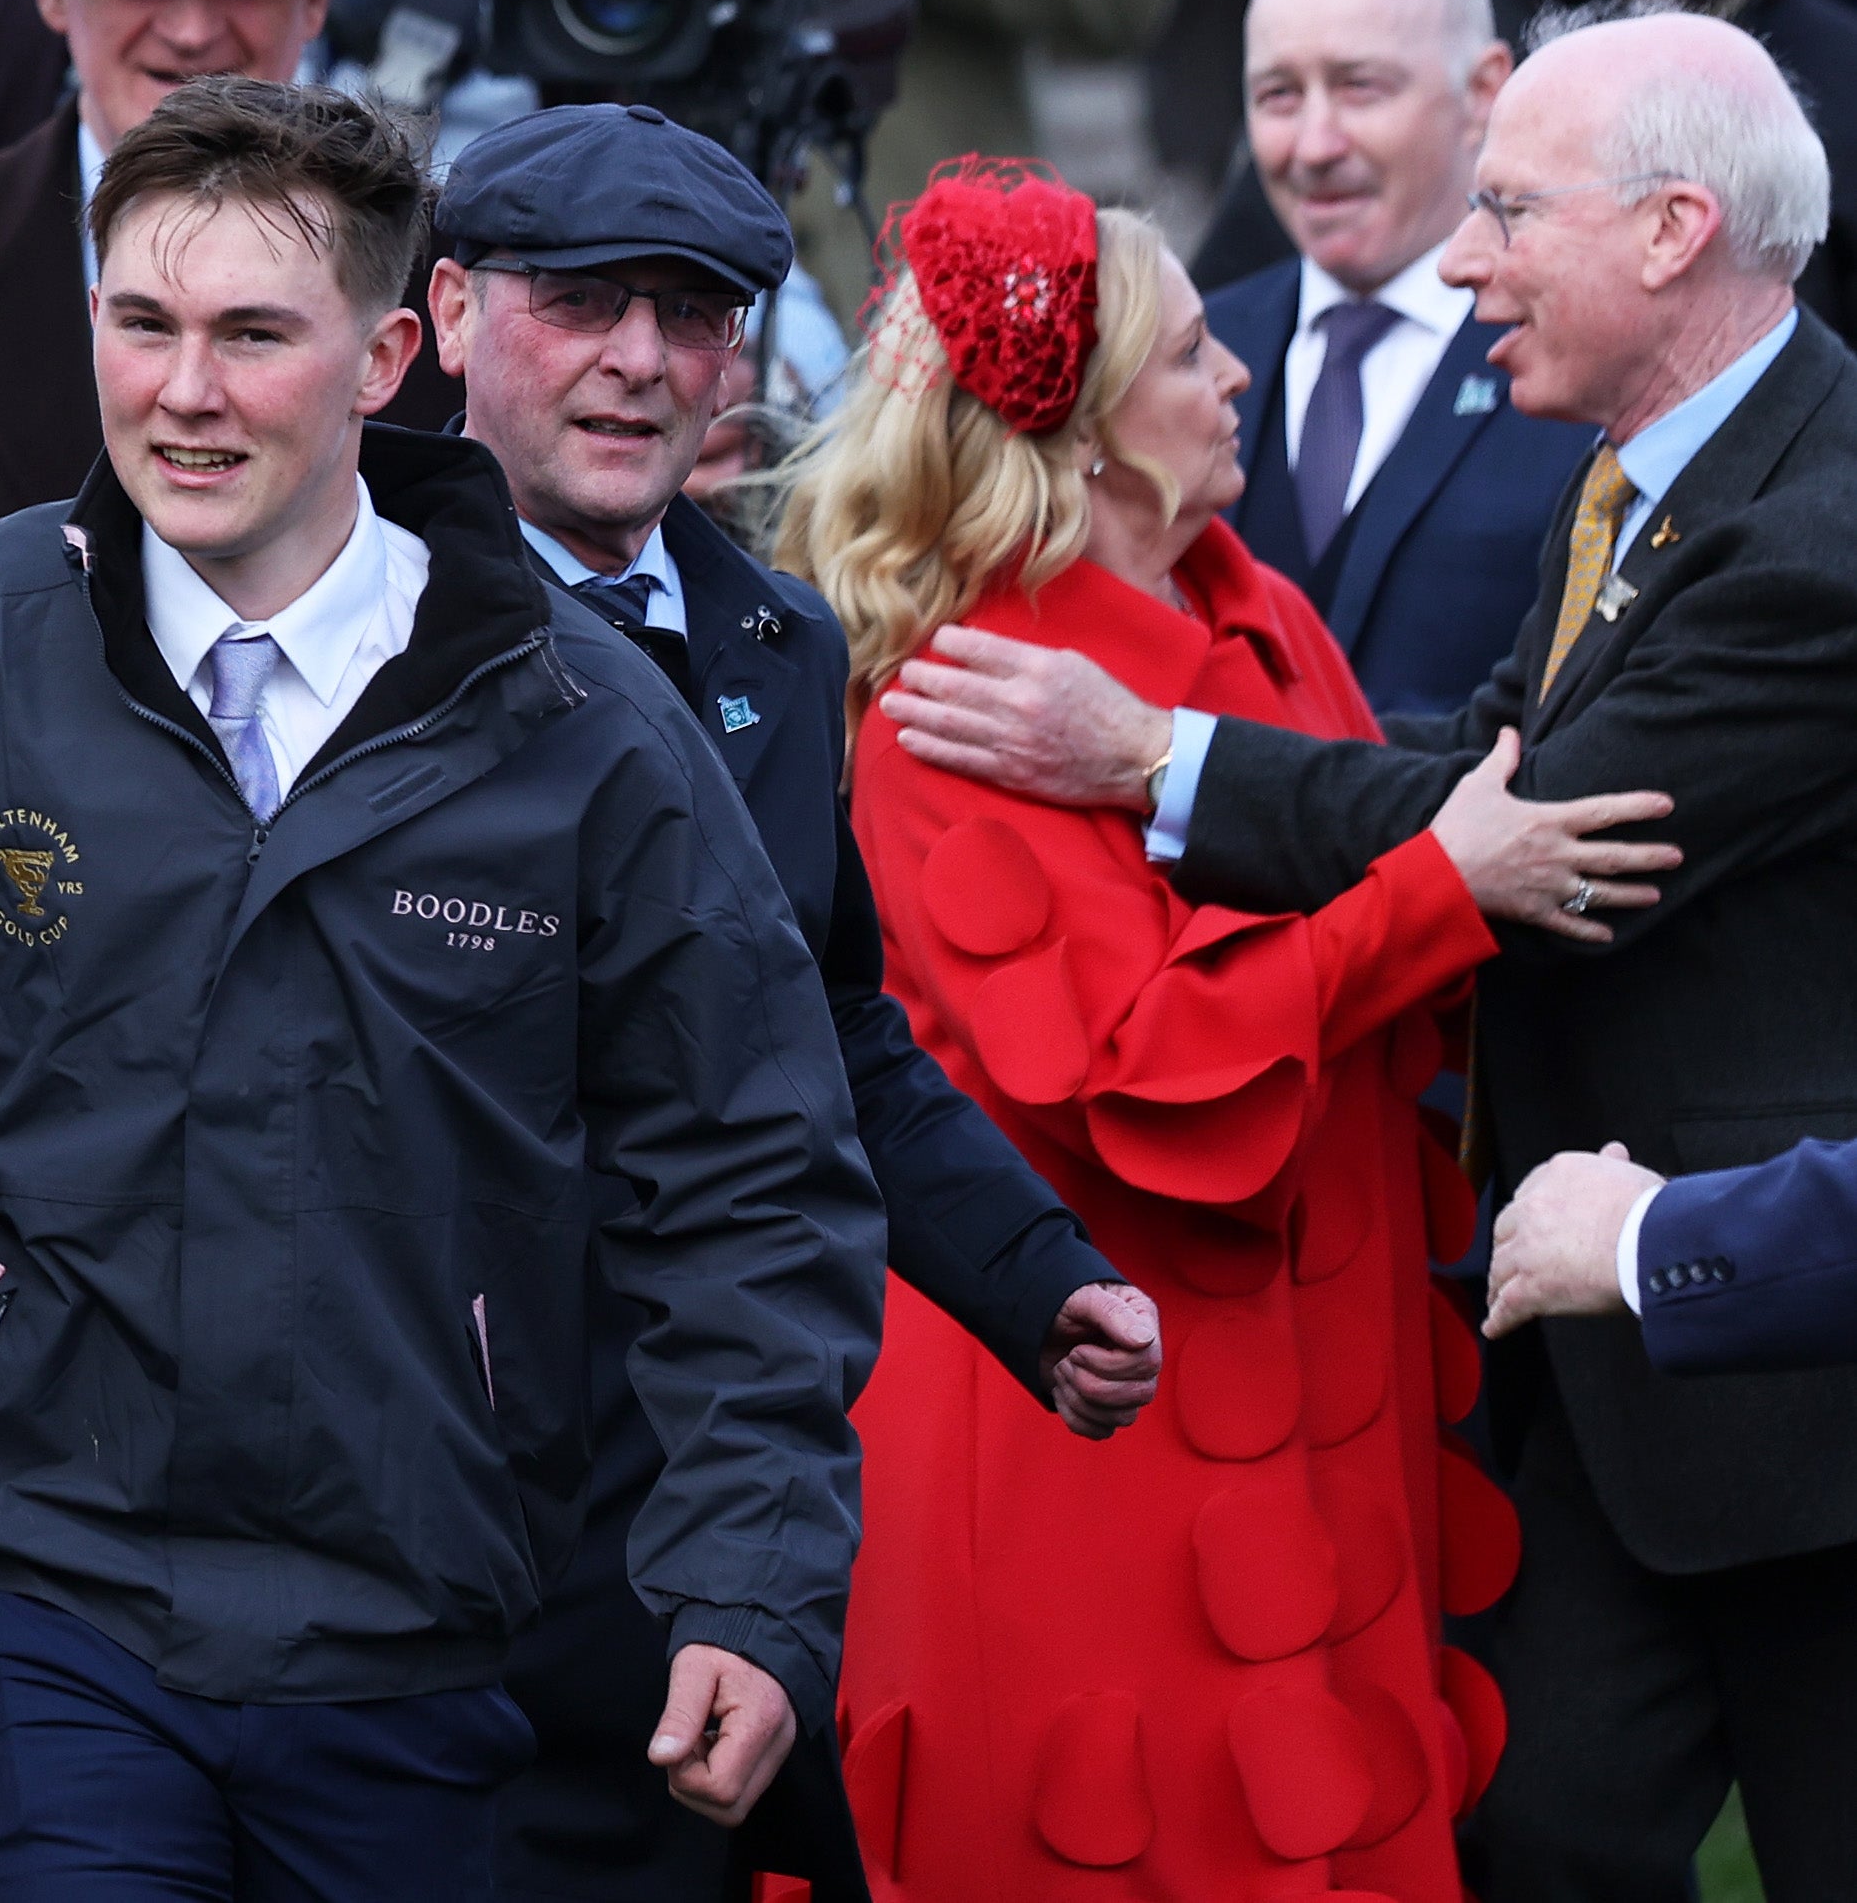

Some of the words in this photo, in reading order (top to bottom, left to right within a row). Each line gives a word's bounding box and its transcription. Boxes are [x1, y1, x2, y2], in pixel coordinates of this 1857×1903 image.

[57, 881, 84, 895] YRS
[391, 889, 561, 937] BOODLES
[39, 915, 69, 946] CUP
[446, 932, 496, 951] 1798
